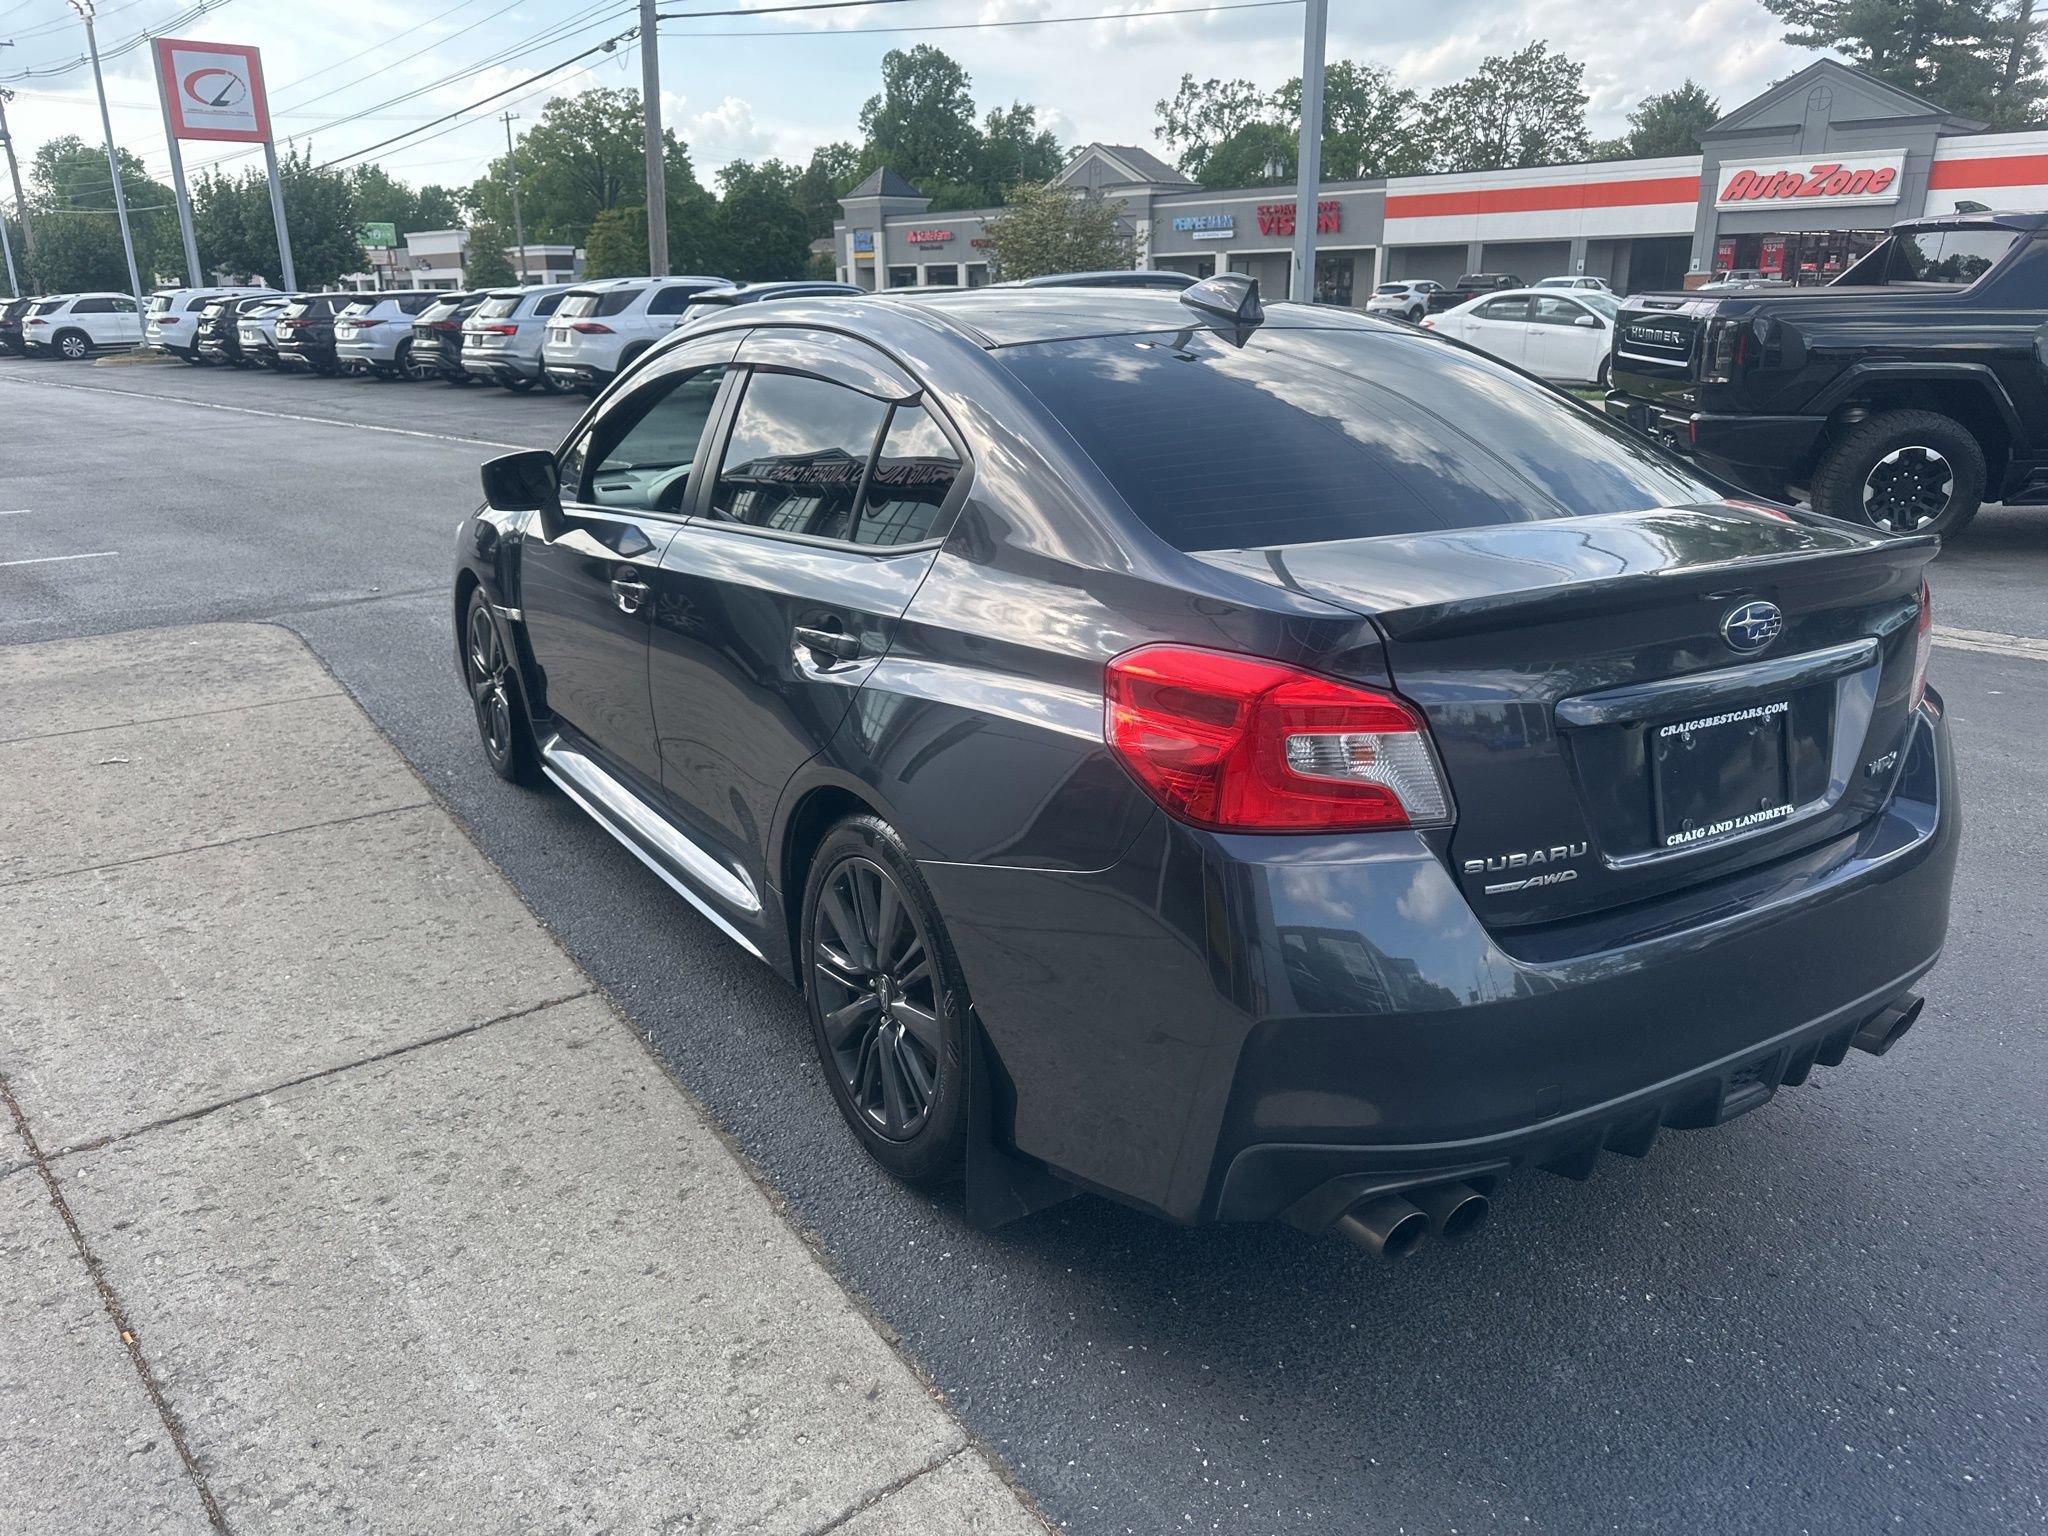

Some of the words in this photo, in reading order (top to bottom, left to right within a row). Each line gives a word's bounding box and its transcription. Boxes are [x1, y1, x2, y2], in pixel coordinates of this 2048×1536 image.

[1719, 163, 1897, 201] AutoZone
[1274, 200, 1341, 216] MATWS
[1257, 212, 1341, 237] VISN
[1631, 326, 1680, 344] HUMMER
[1660, 701, 1788, 737] CRAIGSBESTCARS.COM
[1666, 828, 1705, 847] CRAIG
[1708, 821, 1733, 836] AND
[1736, 804, 1795, 828] LANDRETH
[1463, 841, 1588, 875] SUBARU
[1521, 869, 1578, 890] AWD
